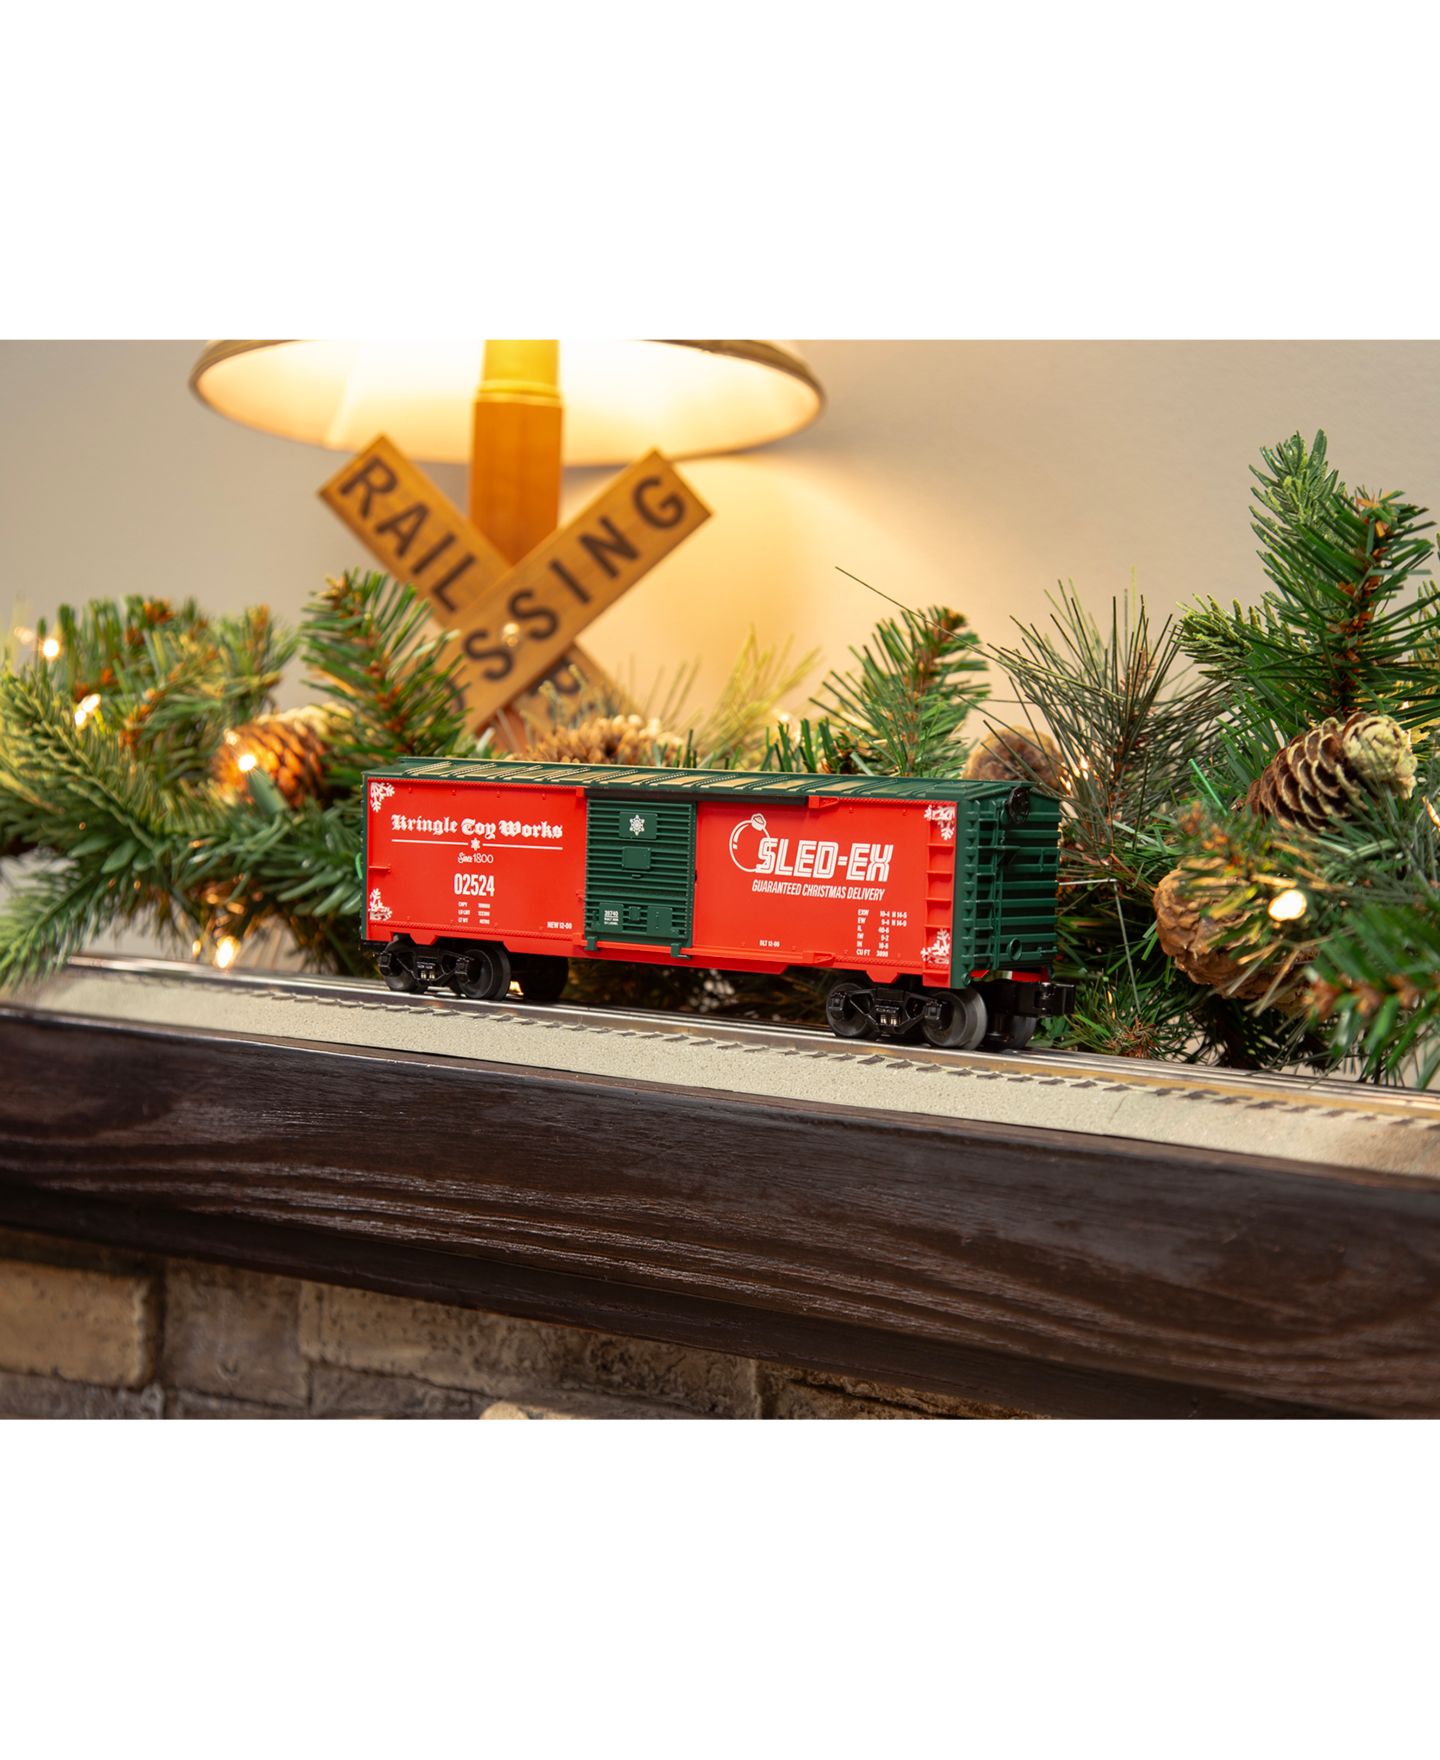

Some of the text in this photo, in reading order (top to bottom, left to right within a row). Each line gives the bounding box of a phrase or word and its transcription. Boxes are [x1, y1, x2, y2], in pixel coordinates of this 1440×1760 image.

[340, 454, 477, 613] RAIL
[446, 475, 686, 711] SSING
[391, 814, 563, 840] Kringle Toy Works
[473, 853, 494, 864] 1800
[755, 837, 894, 882] SLED-EX
[454, 873, 495, 897] 02524
[752, 879, 885, 901] GUARANTEED CHRISTMAS DELIVERY
[547, 921, 559, 929] NEW
